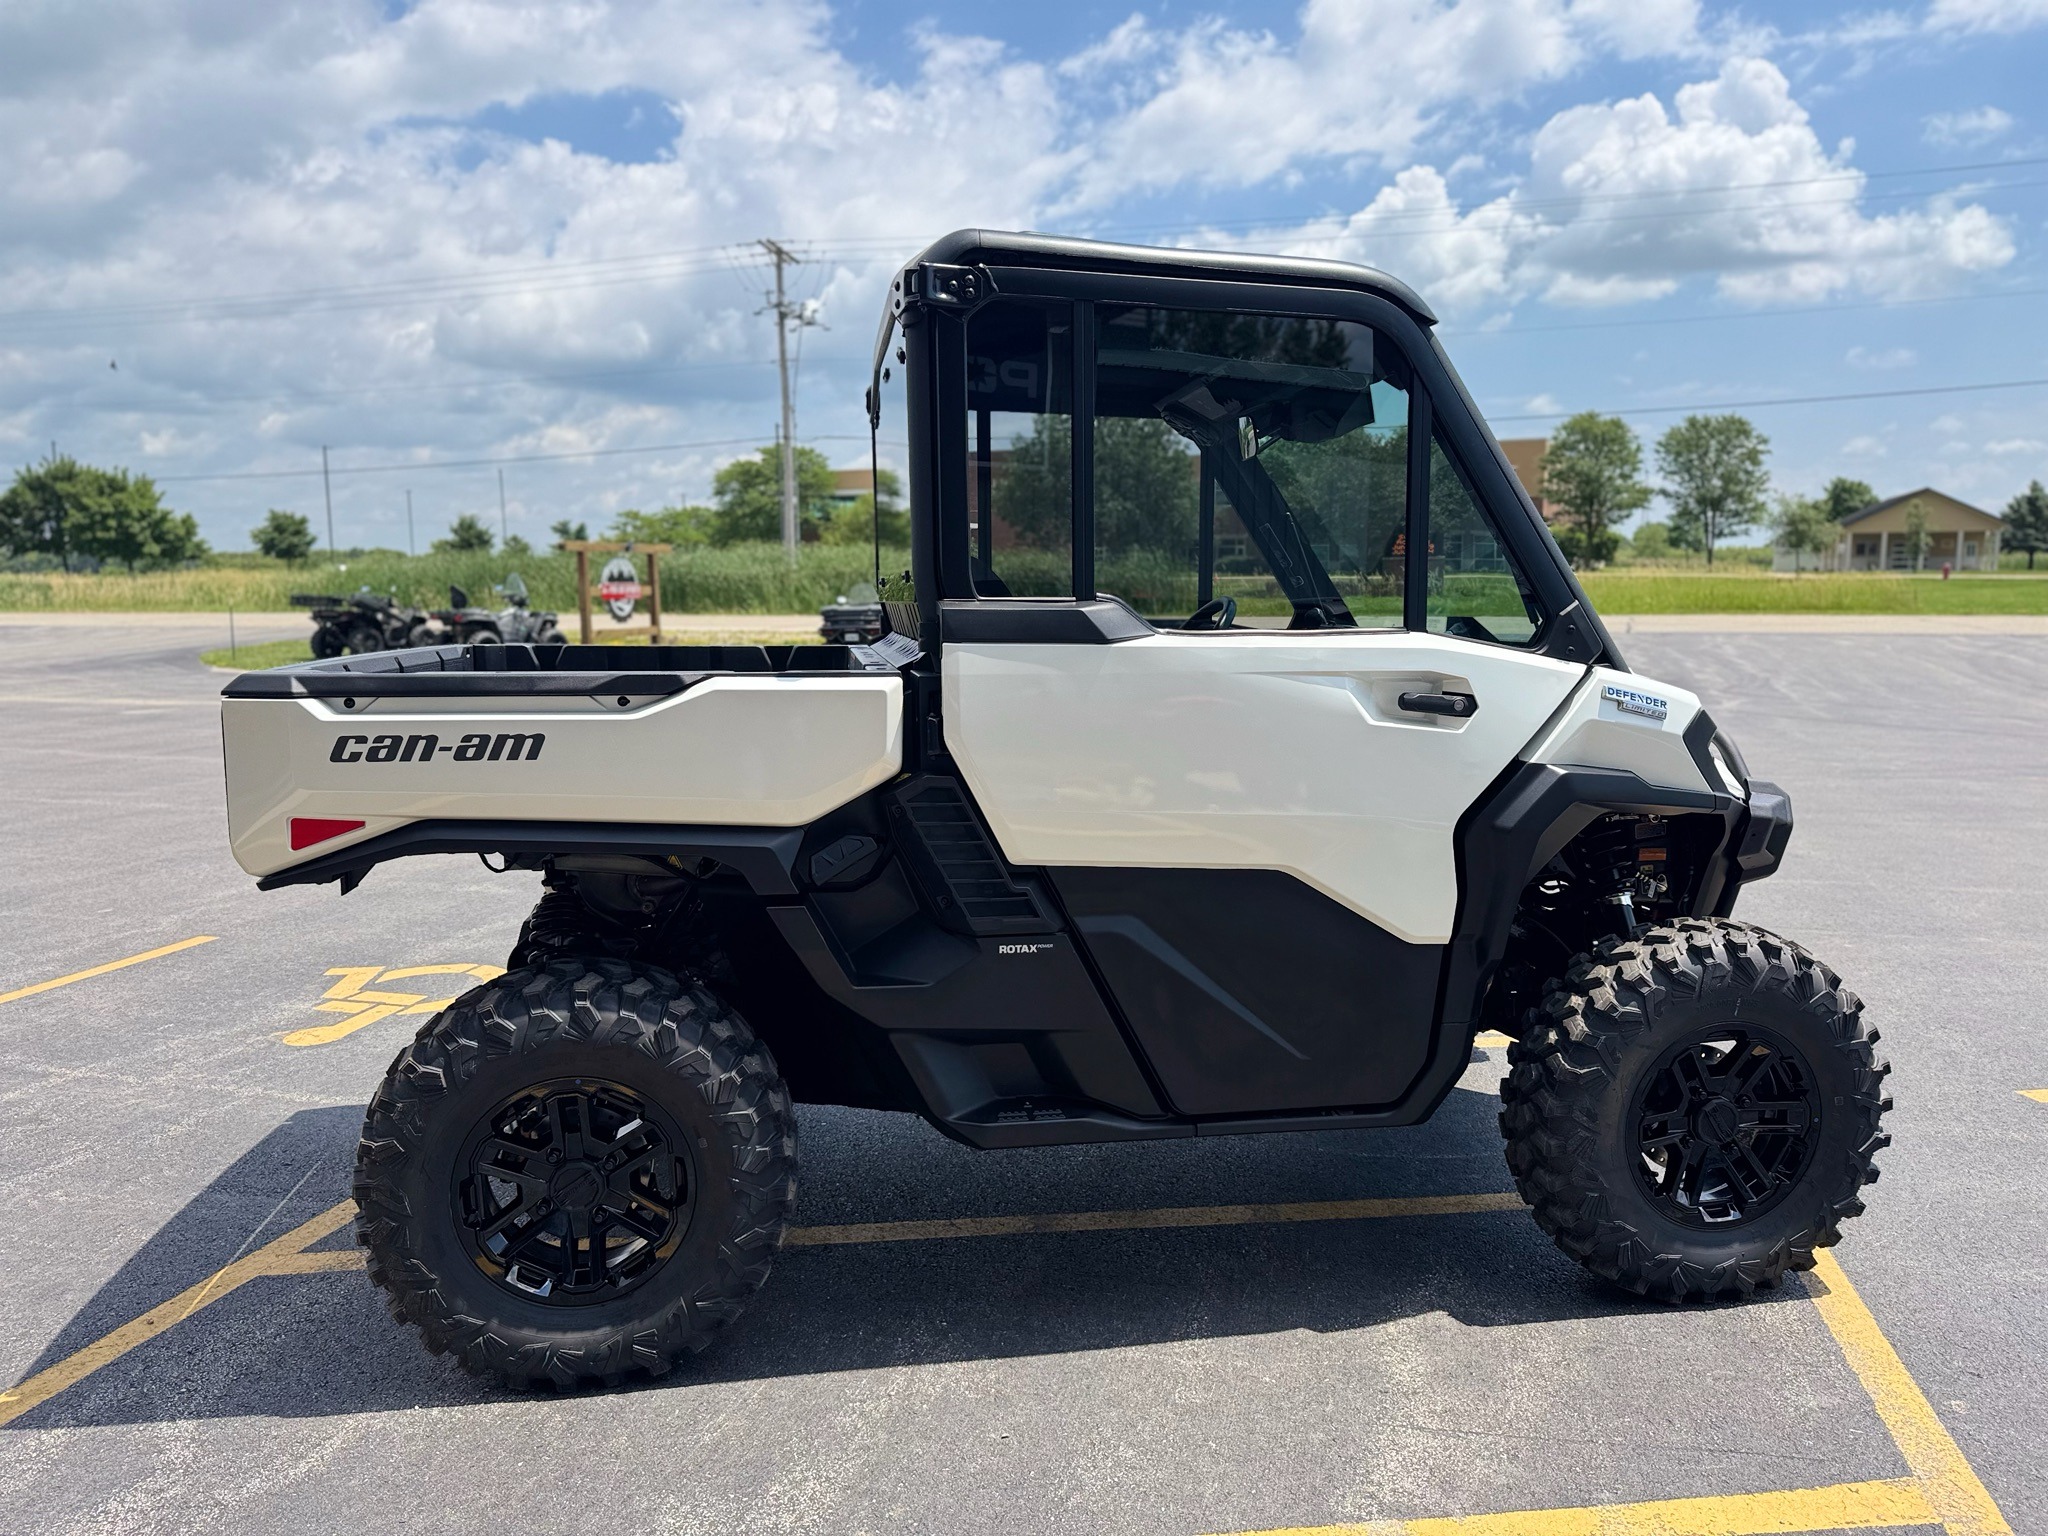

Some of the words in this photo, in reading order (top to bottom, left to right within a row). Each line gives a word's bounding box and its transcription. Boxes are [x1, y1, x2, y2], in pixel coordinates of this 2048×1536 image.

[1607, 687, 1667, 709] DEFENDER
[329, 733, 546, 762] can-am
[999, 944, 1037, 953] ROTAX
